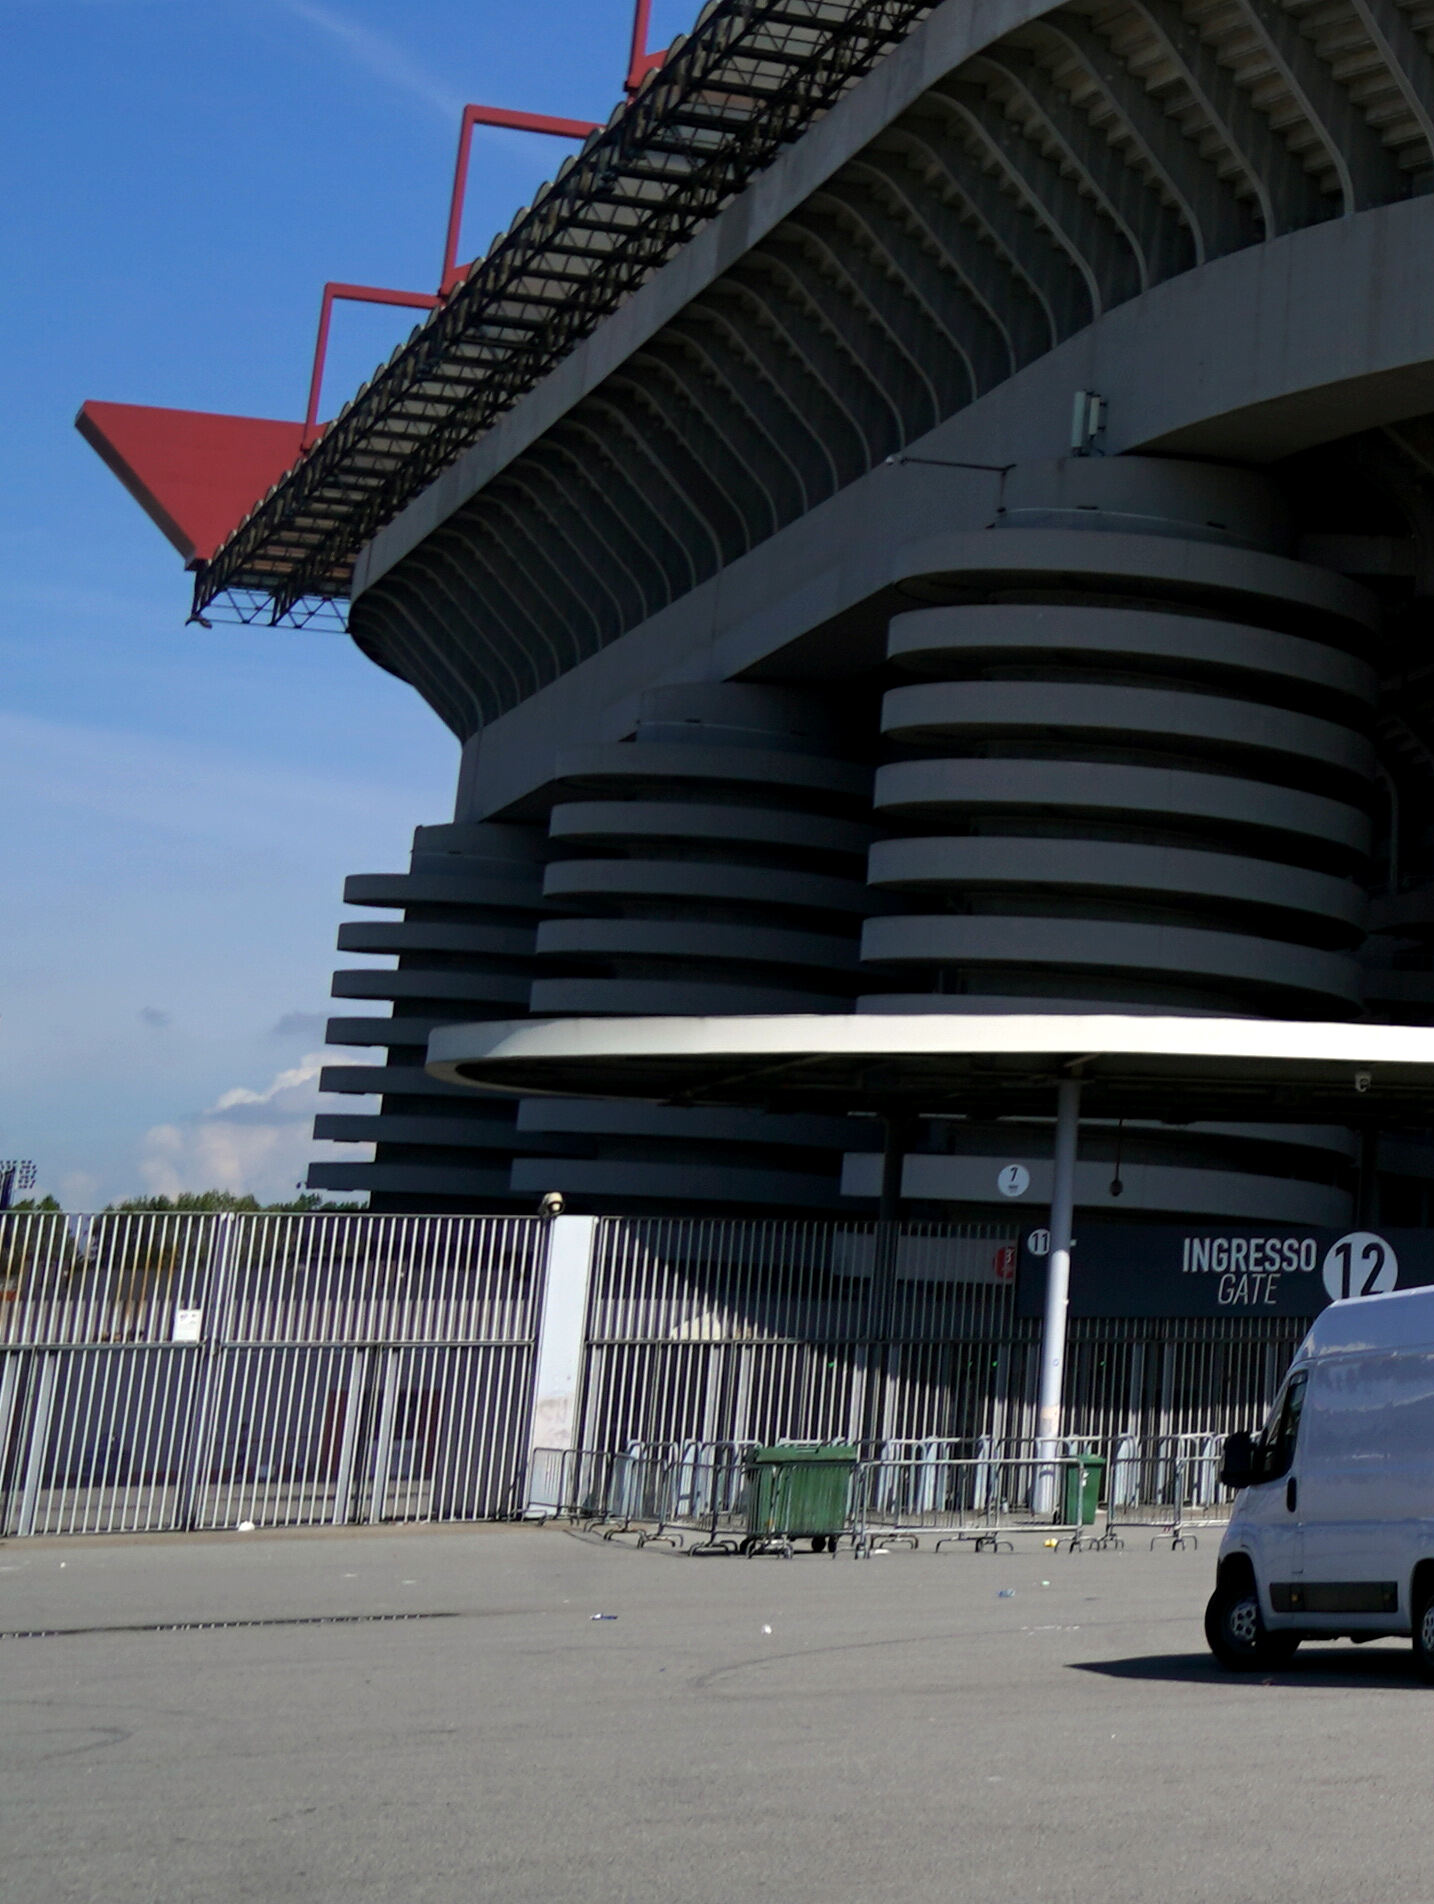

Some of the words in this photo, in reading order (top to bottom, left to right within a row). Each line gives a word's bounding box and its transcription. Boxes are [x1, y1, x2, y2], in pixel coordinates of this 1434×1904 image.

[1009, 1166, 1019, 1183] 7
[1031, 1232, 1049, 1252] 11
[1183, 1237, 1317, 1273] INGRESSO
[1333, 1241, 1386, 1299] 12
[1218, 1273, 1282, 1306] GATE
